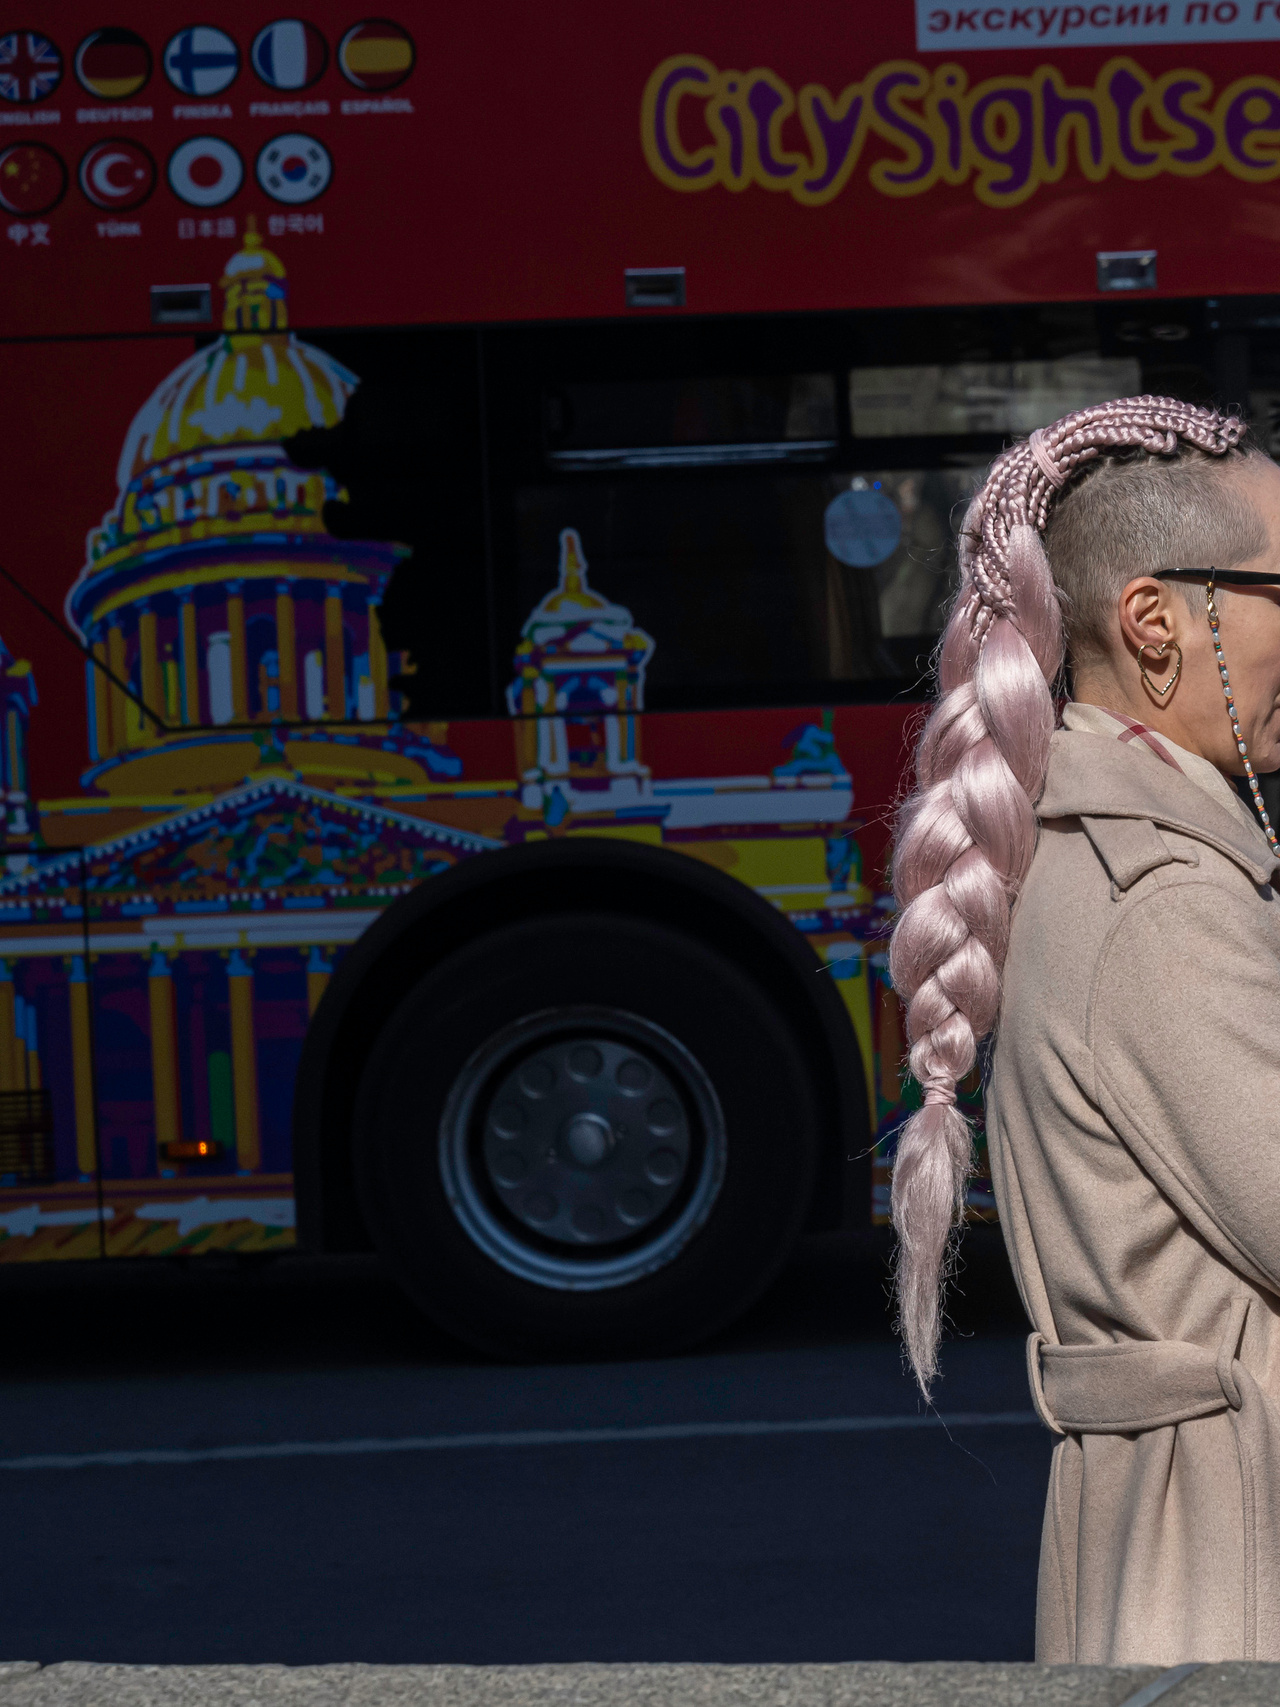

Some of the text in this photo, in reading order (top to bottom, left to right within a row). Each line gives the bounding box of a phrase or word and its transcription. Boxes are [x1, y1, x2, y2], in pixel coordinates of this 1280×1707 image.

[927, 3, 1170, 37] экскурсии
[1183, 1, 1240, 24] по
[76, 106, 153, 124] DEUTSCH
[249, 100, 330, 118] FRANÇAIS
[341, 96, 414, 115] ESPAÑOL
[0, 109, 61, 126] NGLISH
[7, 222, 50, 246] 中文
[178, 216, 236, 239] 日本語
[268, 213, 324, 236] 한국어
